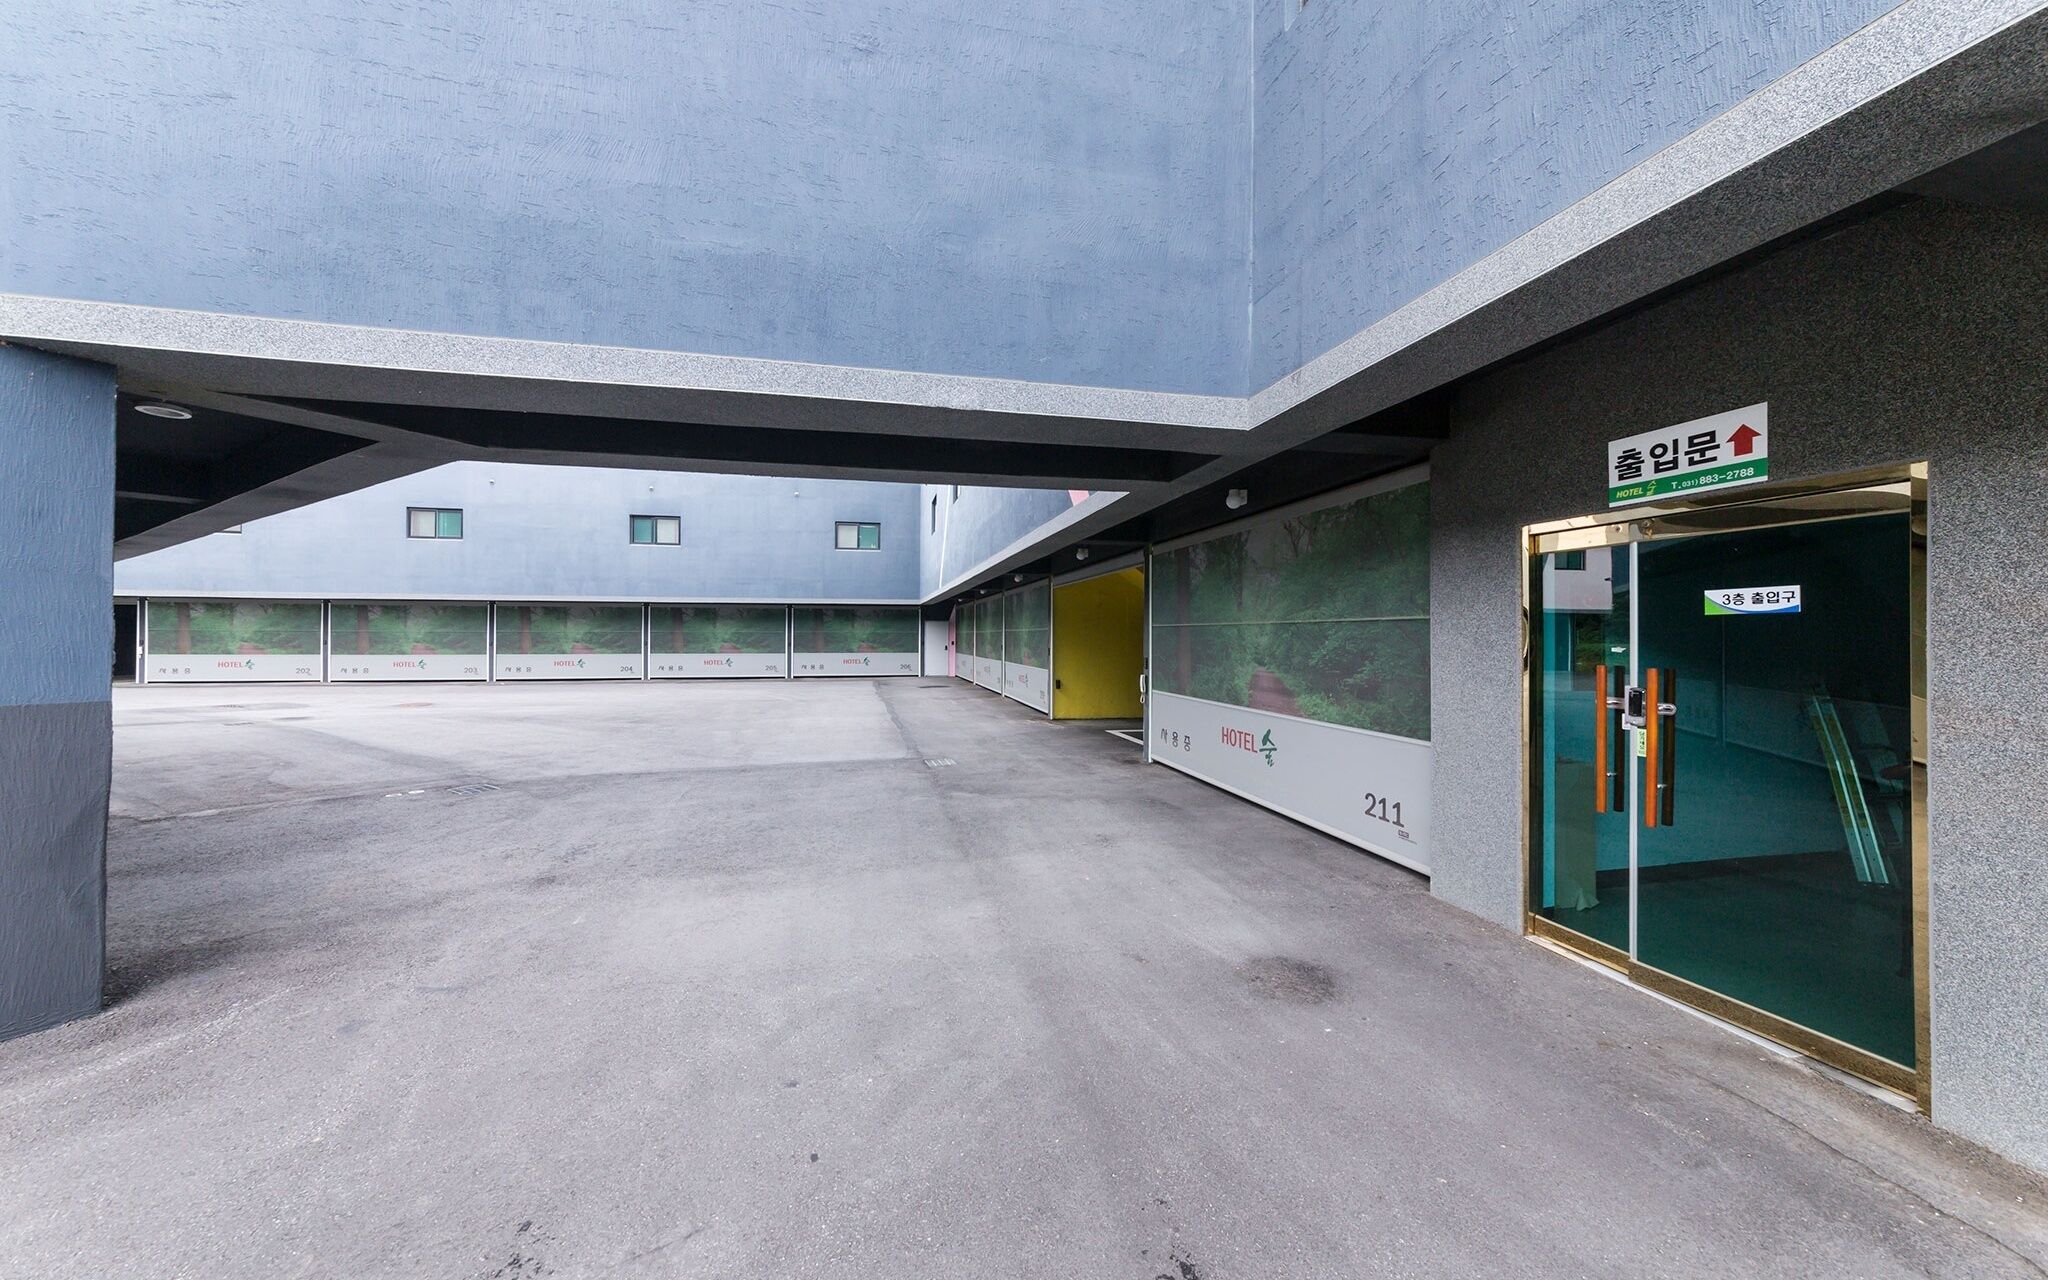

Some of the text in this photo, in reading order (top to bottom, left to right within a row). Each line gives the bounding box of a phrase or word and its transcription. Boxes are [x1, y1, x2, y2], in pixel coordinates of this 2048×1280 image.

[1614, 430, 1721, 482] 출입문
[1616, 487, 1644, 498] HOTEL
[1722, 590, 1796, 606] 3층 출입구
[1221, 726, 1258, 753] HOTEL
[1364, 792, 1404, 828] 211
